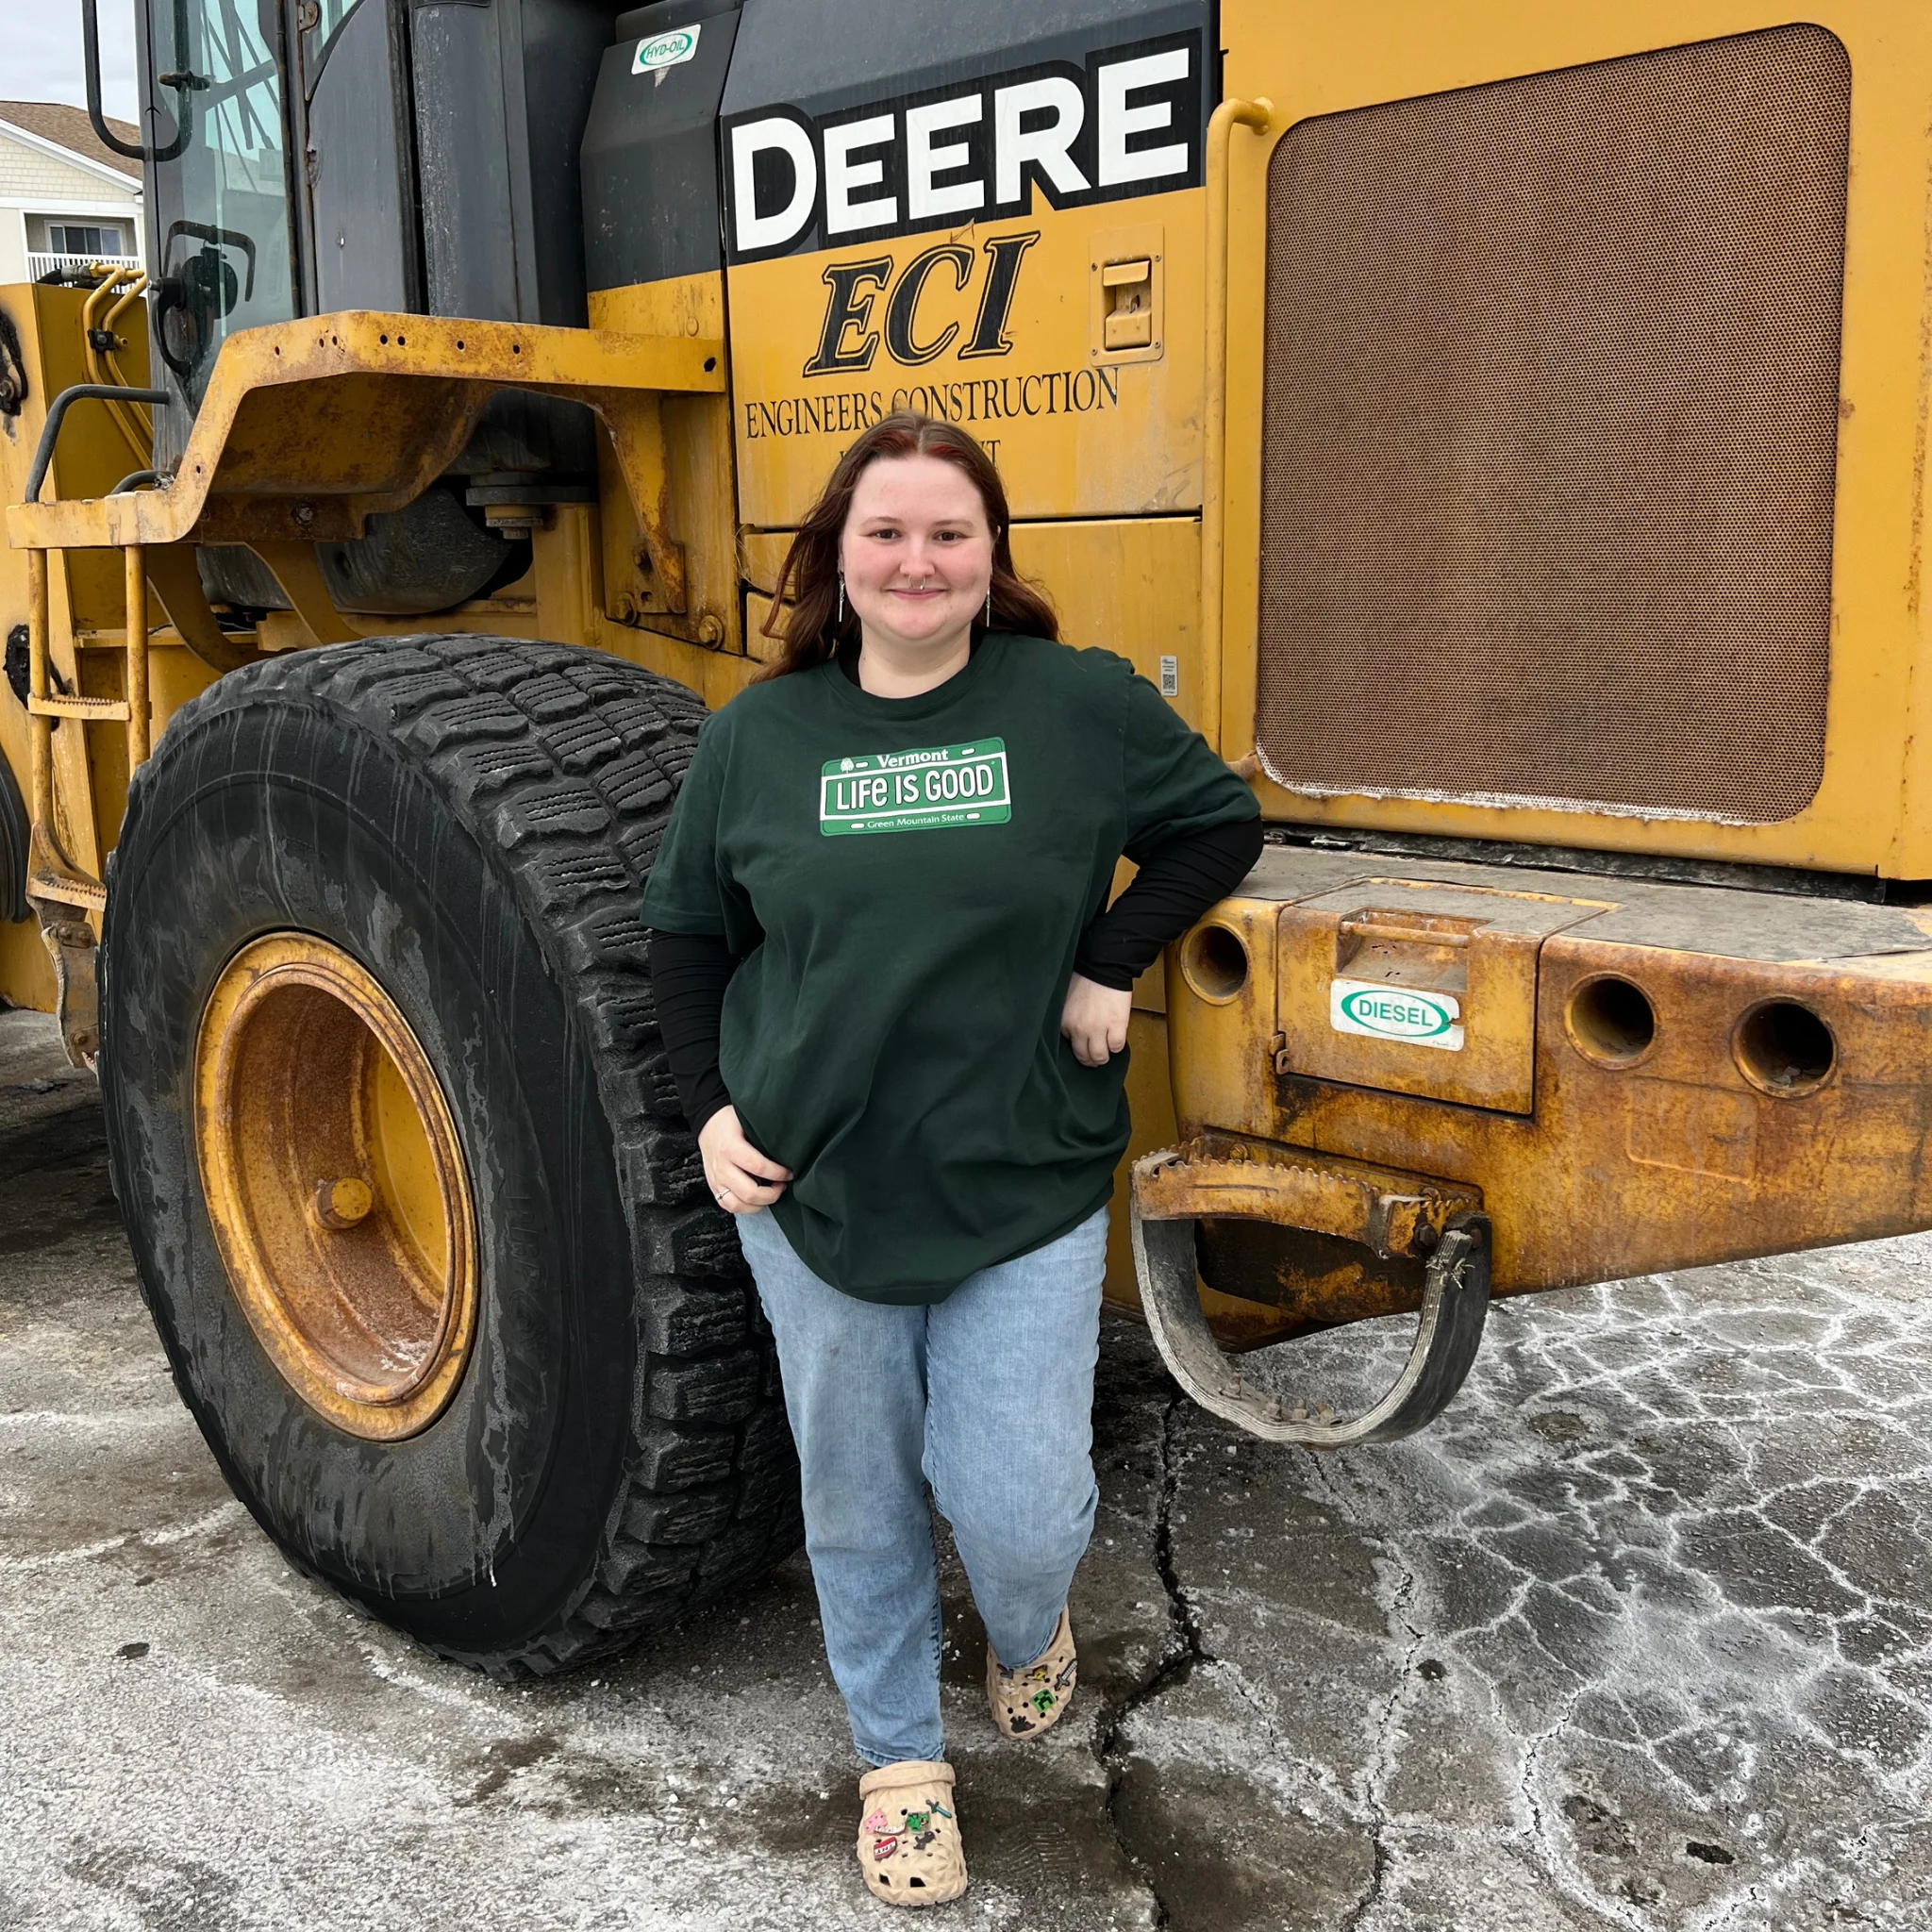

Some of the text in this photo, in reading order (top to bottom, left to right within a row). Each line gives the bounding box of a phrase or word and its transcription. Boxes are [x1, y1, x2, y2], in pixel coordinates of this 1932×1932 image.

[646, 40, 684, 58] HYD-OIL
[731, 48, 1190, 252] DEERE
[802, 231, 1041, 378] ECI
[746, 367, 1120, 439] ENGINEERS CONSTRUCTION
[877, 749, 949, 768] Vermont
[895, 774, 920, 806] IS
[924, 764, 995, 802] GOOD
[867, 813, 965, 829] Green Mountain State
[1359, 1000, 1433, 1027] DIESEL
